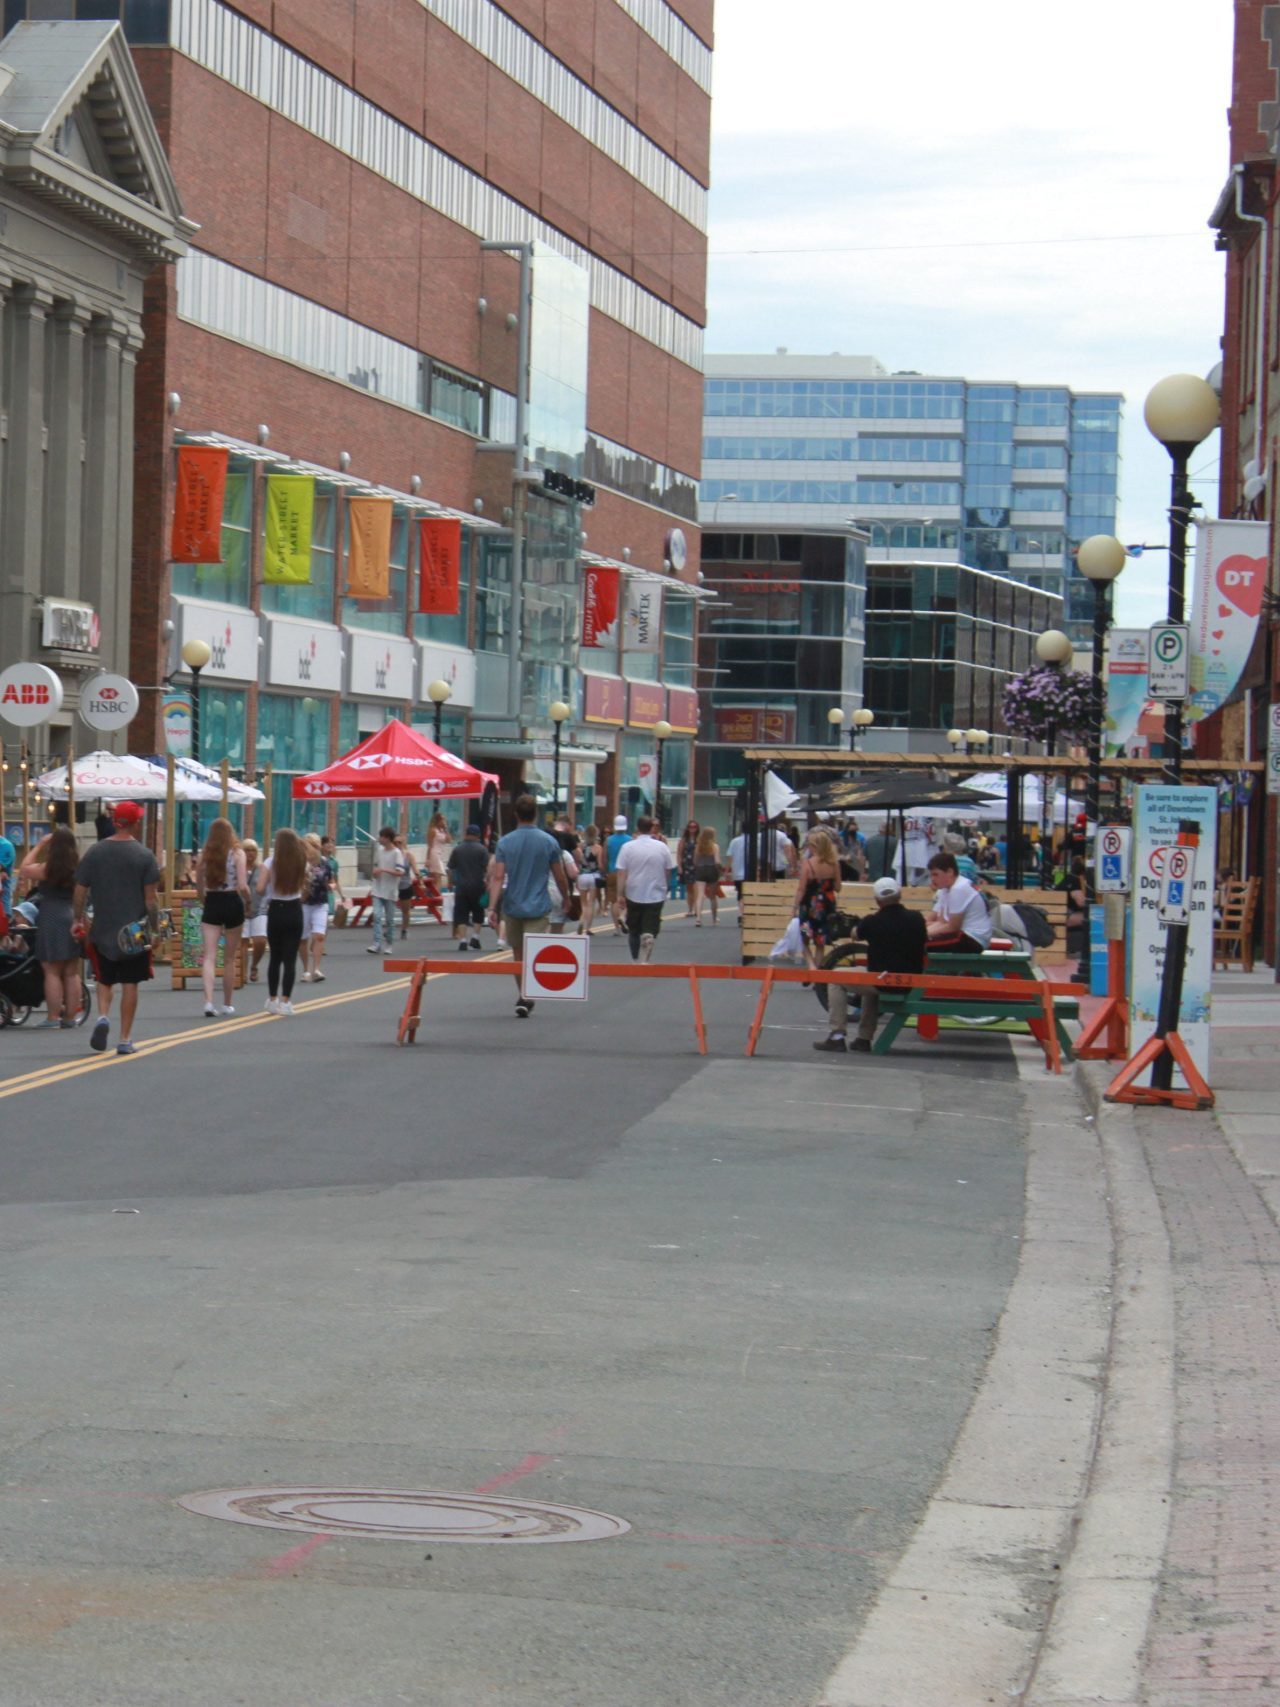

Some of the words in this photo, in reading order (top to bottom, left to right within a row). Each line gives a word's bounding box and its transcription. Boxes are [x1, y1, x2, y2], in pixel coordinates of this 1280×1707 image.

[289, 511, 300, 556] MARKET
[1224, 570, 1254, 586] DT
[639, 593, 651, 644] MARTEK
[211, 635, 226, 670] bdc
[298, 648, 312, 680] bdc
[2, 684, 50, 705] ABB
[89, 700, 129, 714] HSBC
[394, 756, 434, 767] HSBC
[75, 771, 150, 787] Coors
[447, 780, 470, 788] HSBC
[332, 784, 354, 792] HSBC
[1182, 794, 1209, 803] explore
[1167, 804, 1206, 813] Downtown
